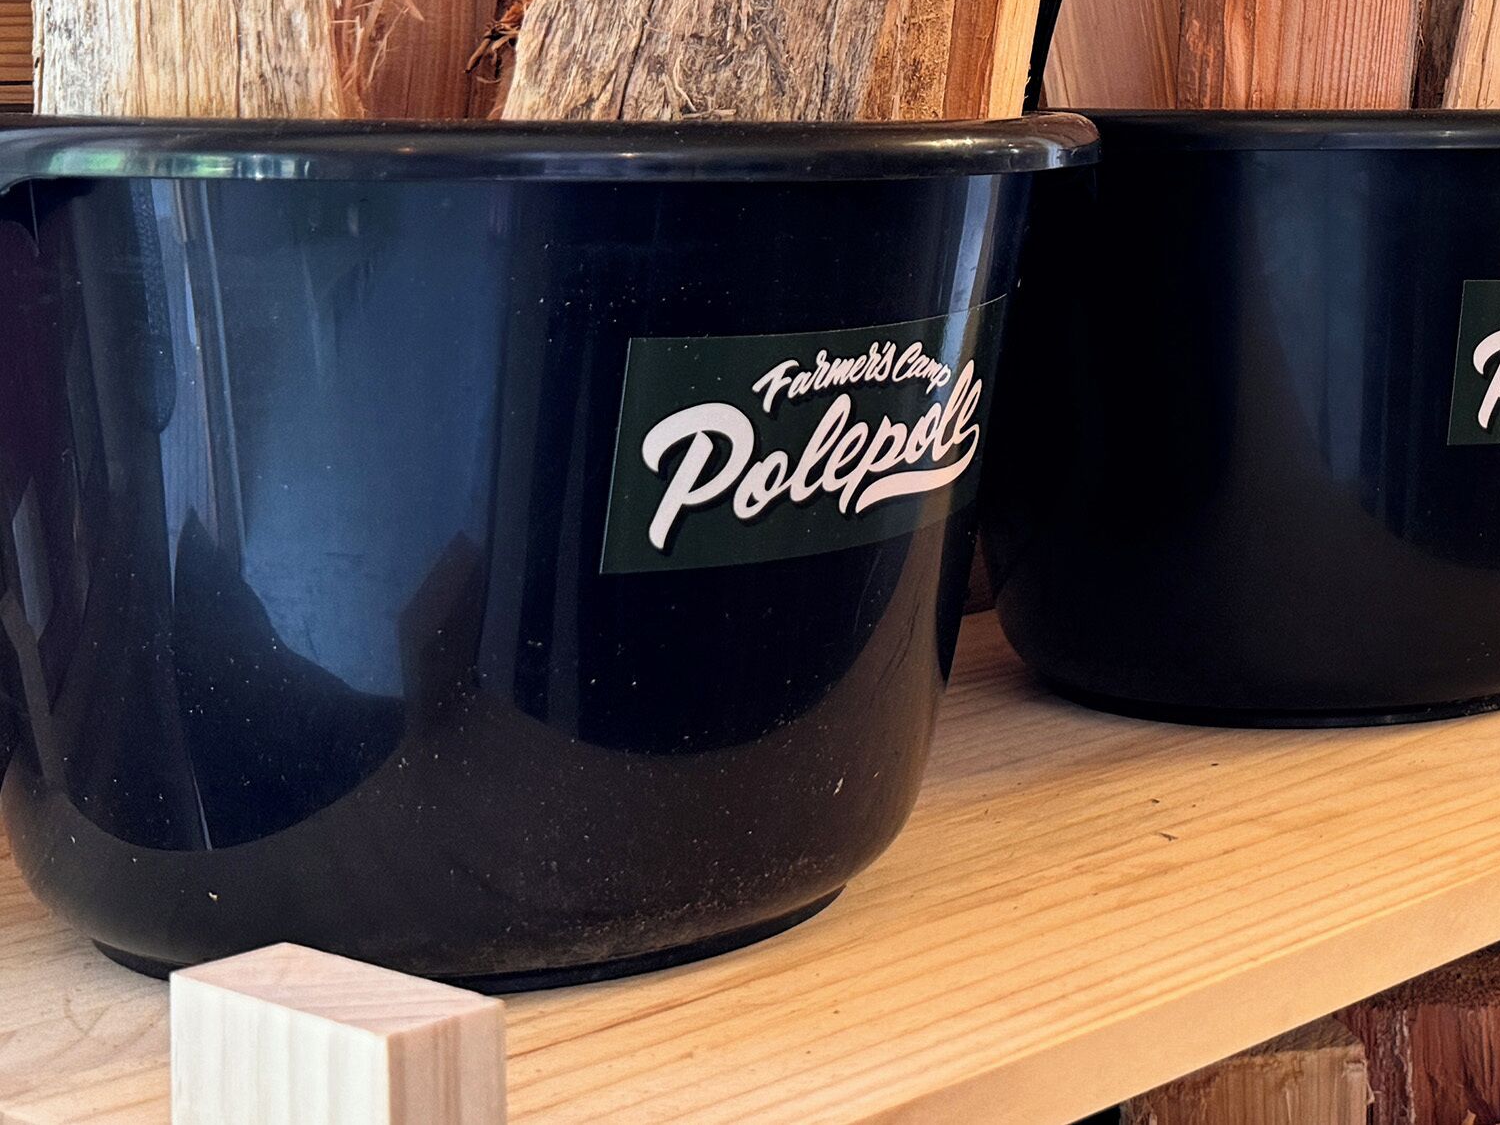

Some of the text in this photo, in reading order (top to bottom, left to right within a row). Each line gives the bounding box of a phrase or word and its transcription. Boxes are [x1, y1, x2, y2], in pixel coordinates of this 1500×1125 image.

[752, 341, 952, 413] Farmer's Camp
[642, 359, 983, 551] Polepole
